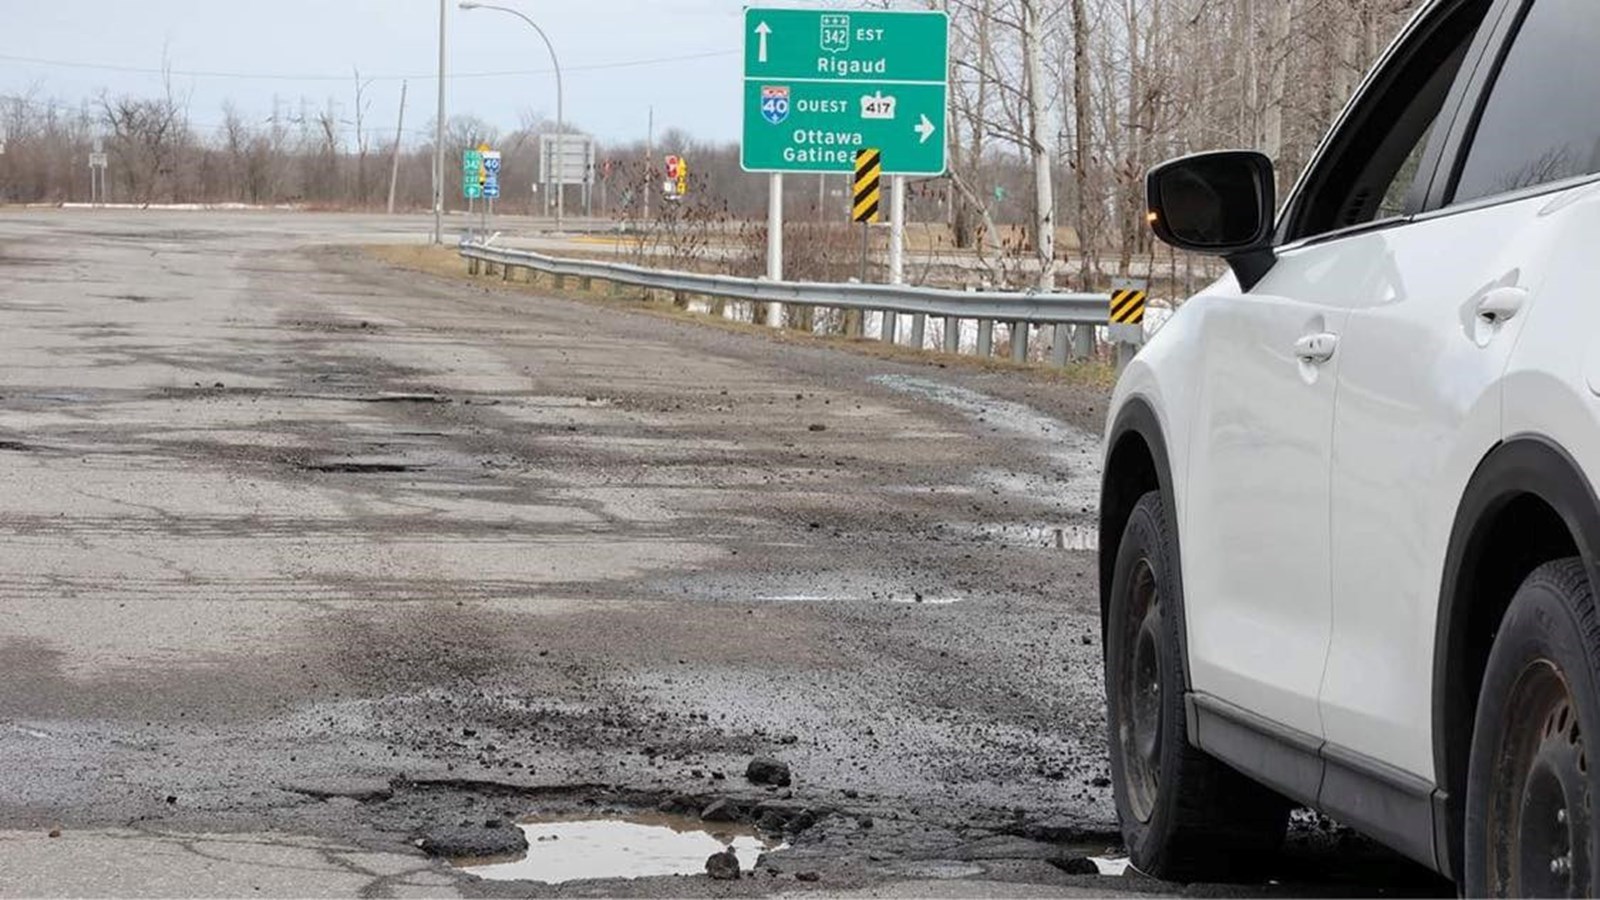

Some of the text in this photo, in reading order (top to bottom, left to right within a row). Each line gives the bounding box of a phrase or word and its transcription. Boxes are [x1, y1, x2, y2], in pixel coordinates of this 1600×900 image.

[824, 28, 884, 45] 342 EST
[817, 56, 886, 76] Rigaud
[763, 99, 891, 114] 40 OUEST 417
[793, 129, 862, 145] Ottawa
[783, 147, 857, 163] Gatinea
